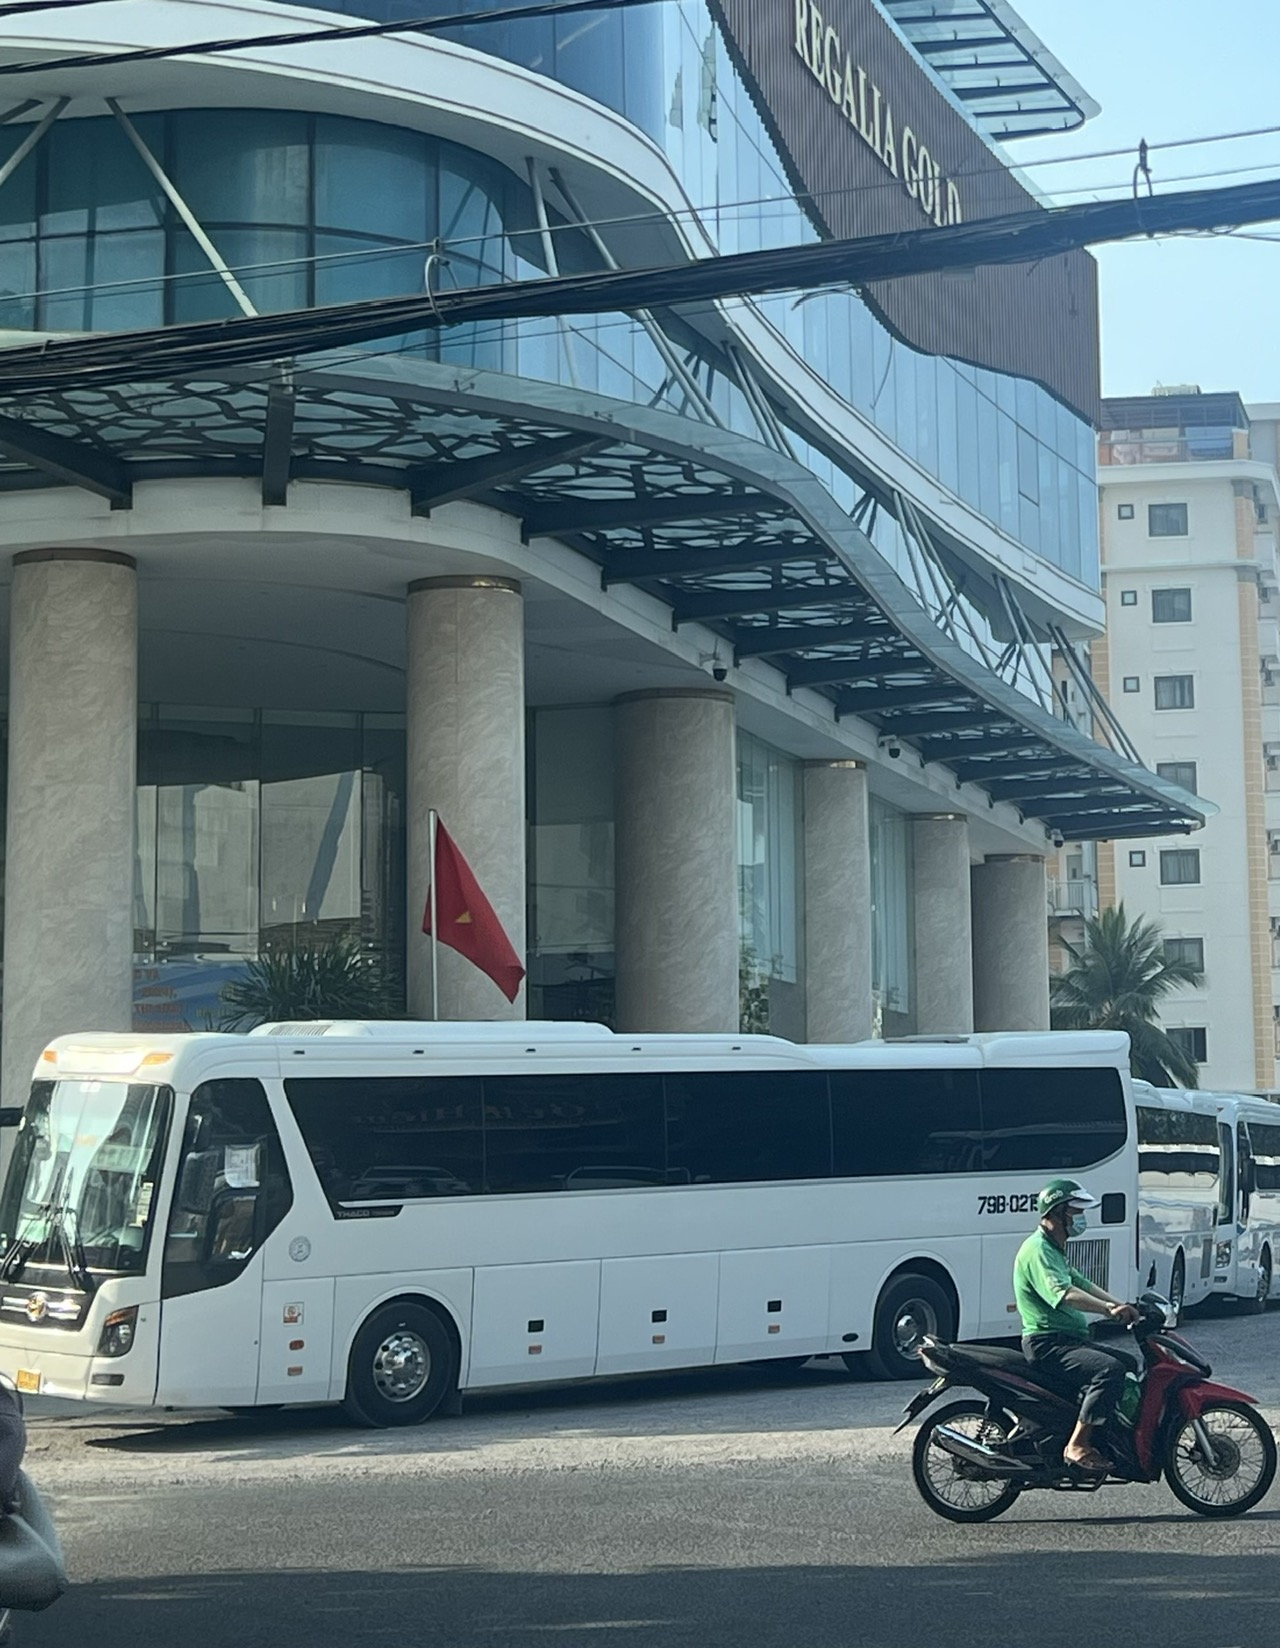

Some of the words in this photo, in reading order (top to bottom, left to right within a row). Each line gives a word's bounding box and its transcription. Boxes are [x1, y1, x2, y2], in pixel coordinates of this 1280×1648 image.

[795, 0, 898, 179] REGALIA
[902, 126, 962, 227] GOLD
[1043, 1190, 1063, 1204] Grab
